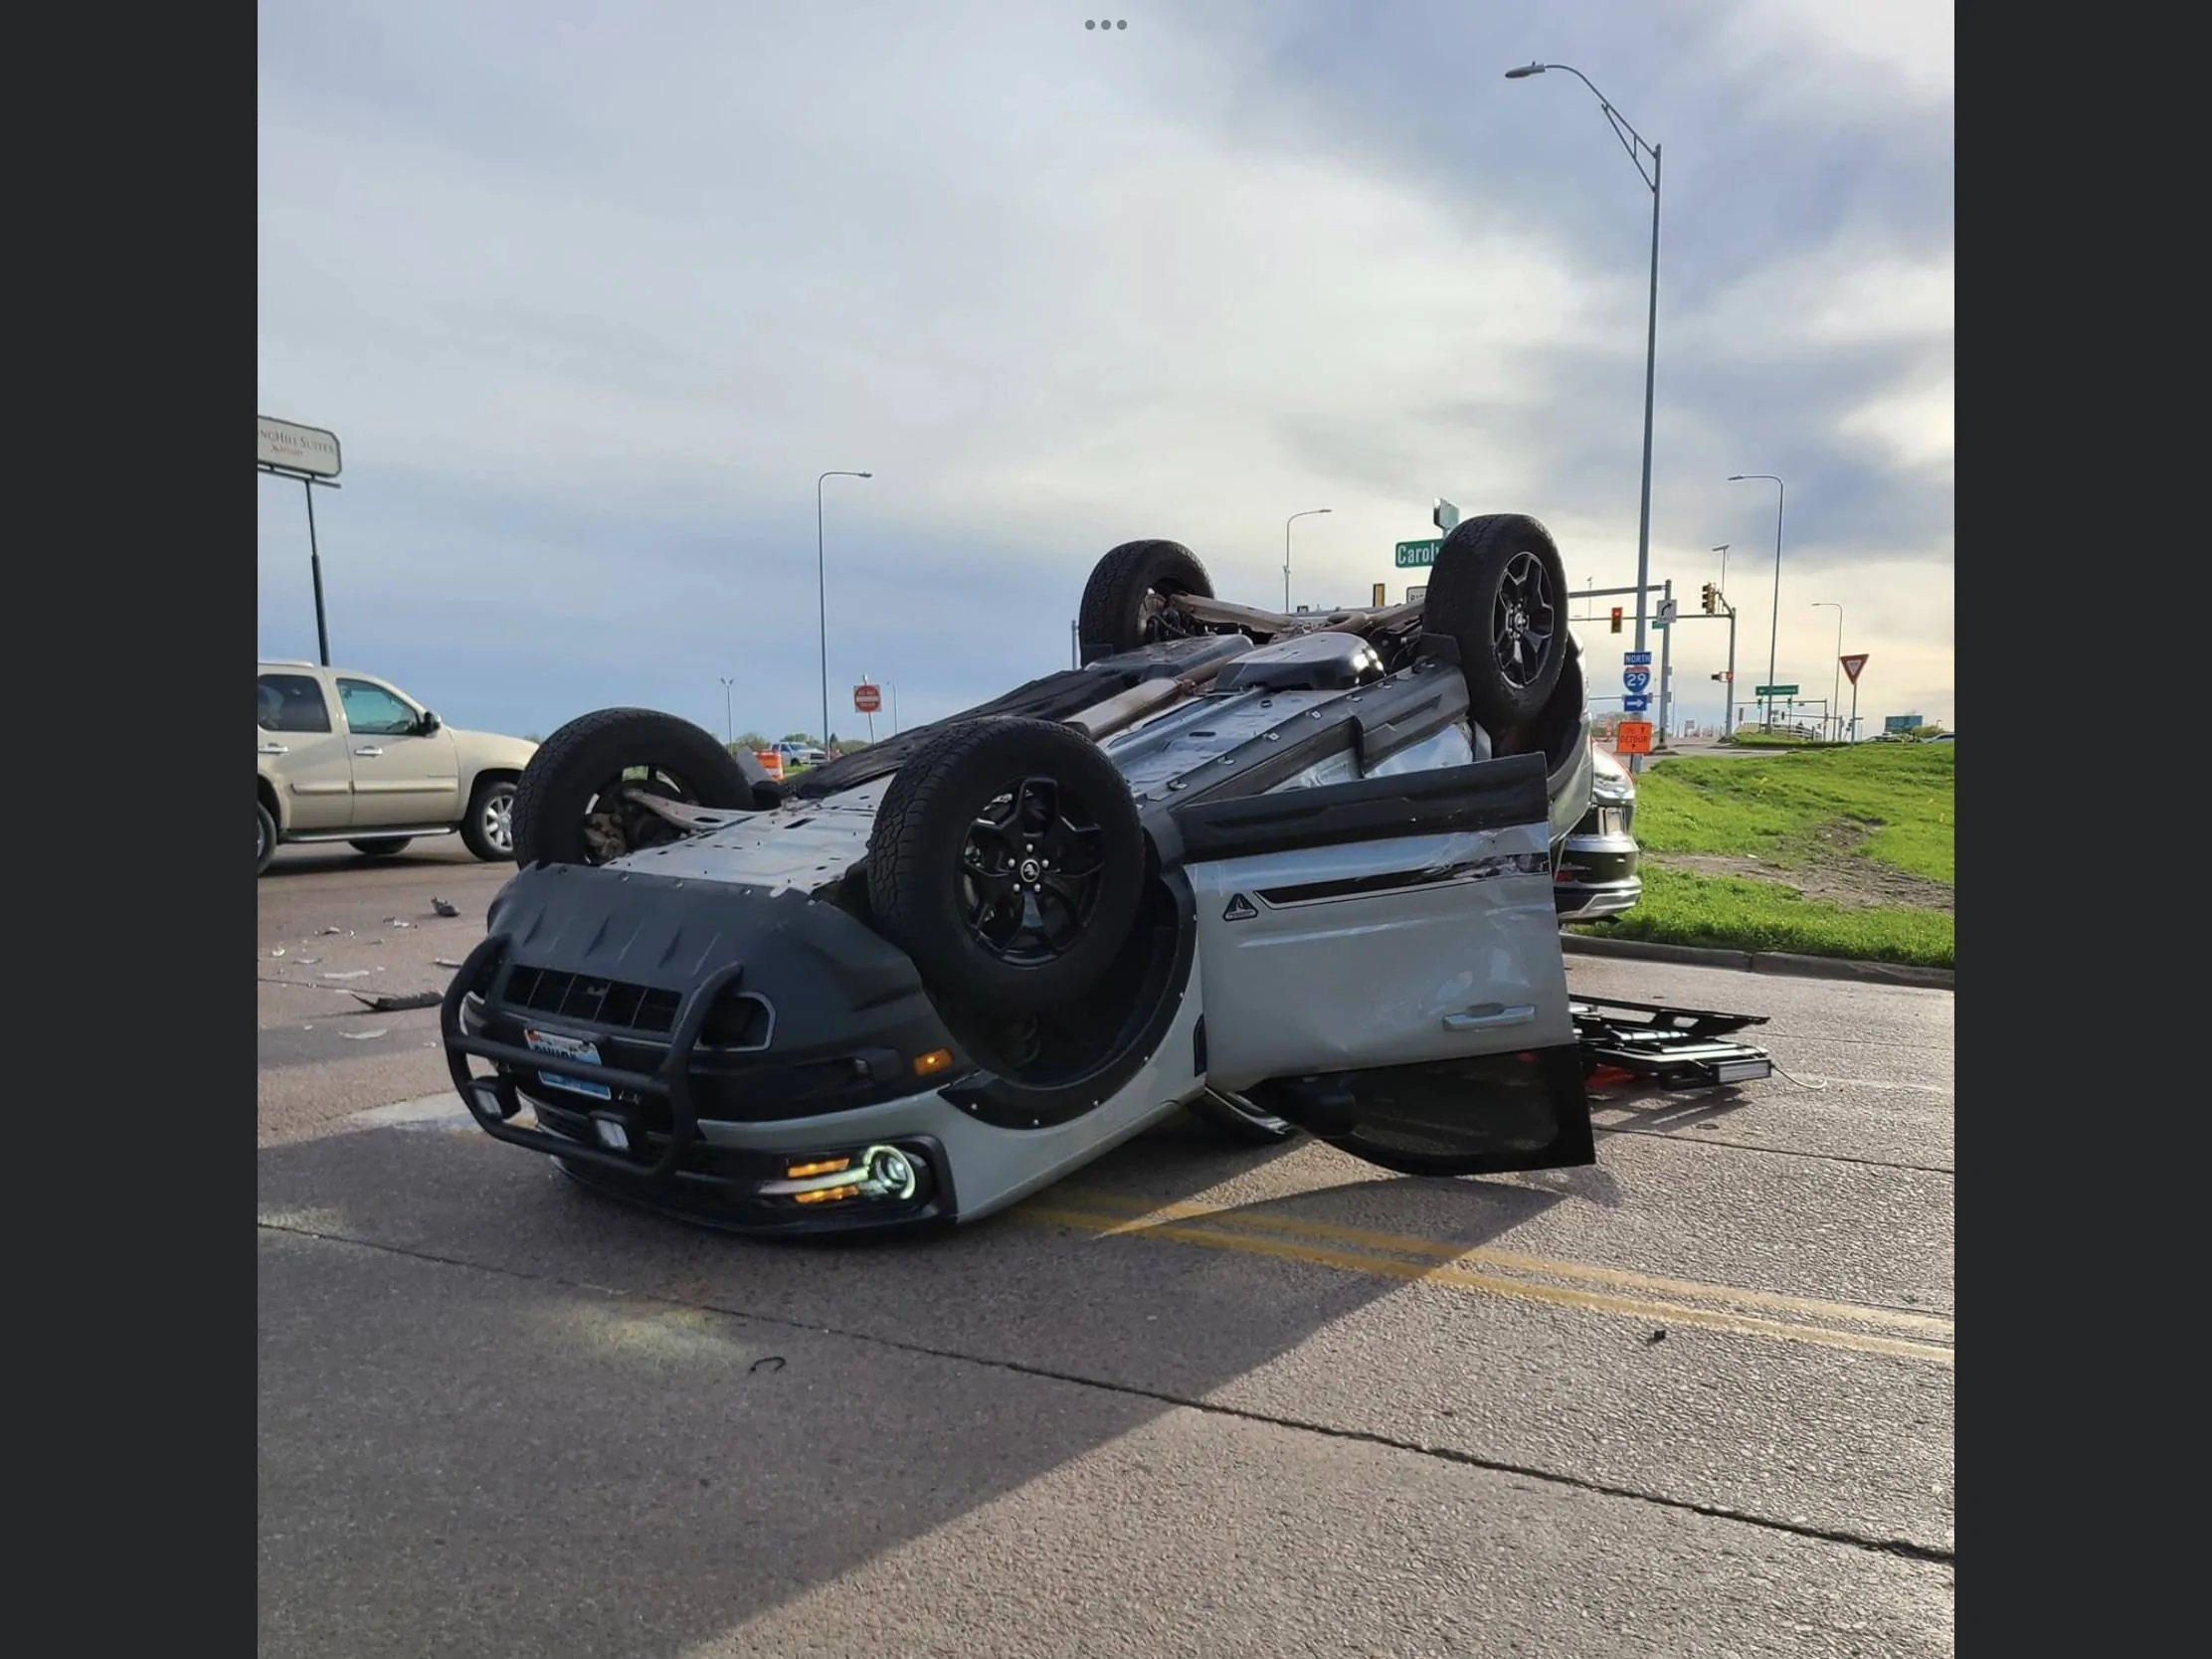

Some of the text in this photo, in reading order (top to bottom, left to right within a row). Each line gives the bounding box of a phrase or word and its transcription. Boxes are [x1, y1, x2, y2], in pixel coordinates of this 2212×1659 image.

[1397, 543, 1439, 564] Carol
[1625, 654, 1651, 663] NORTH
[1627, 673, 1646, 686] 29
